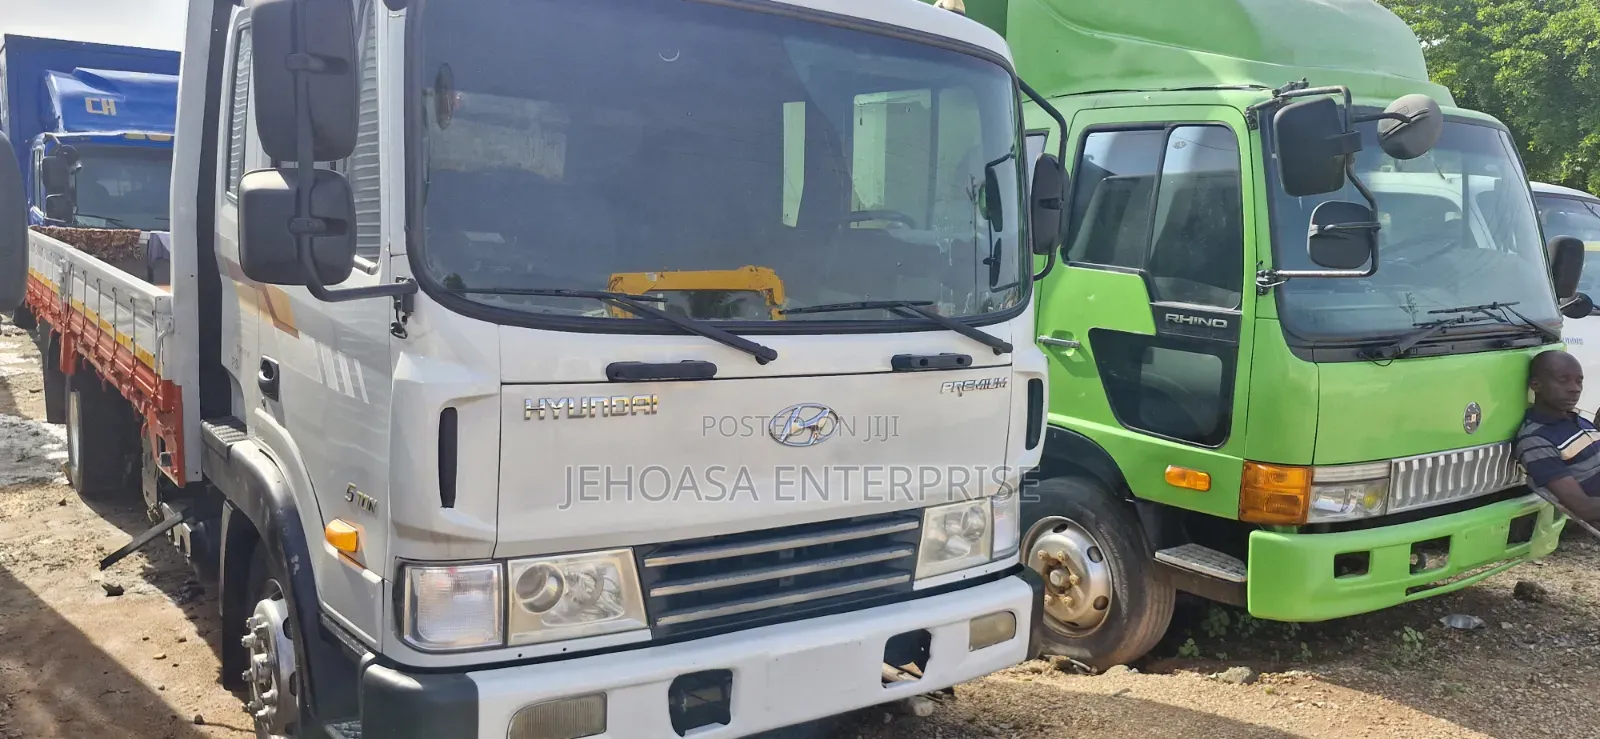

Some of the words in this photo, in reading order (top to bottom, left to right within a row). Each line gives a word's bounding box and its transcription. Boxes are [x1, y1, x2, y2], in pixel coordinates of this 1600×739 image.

[84, 97, 117, 116] CH
[1165, 313, 1228, 329] RHINO
[940, 377, 1008, 397] PREMIUM
[524, 394, 658, 420] HYUNDAI
[345, 481, 357, 503] 5
